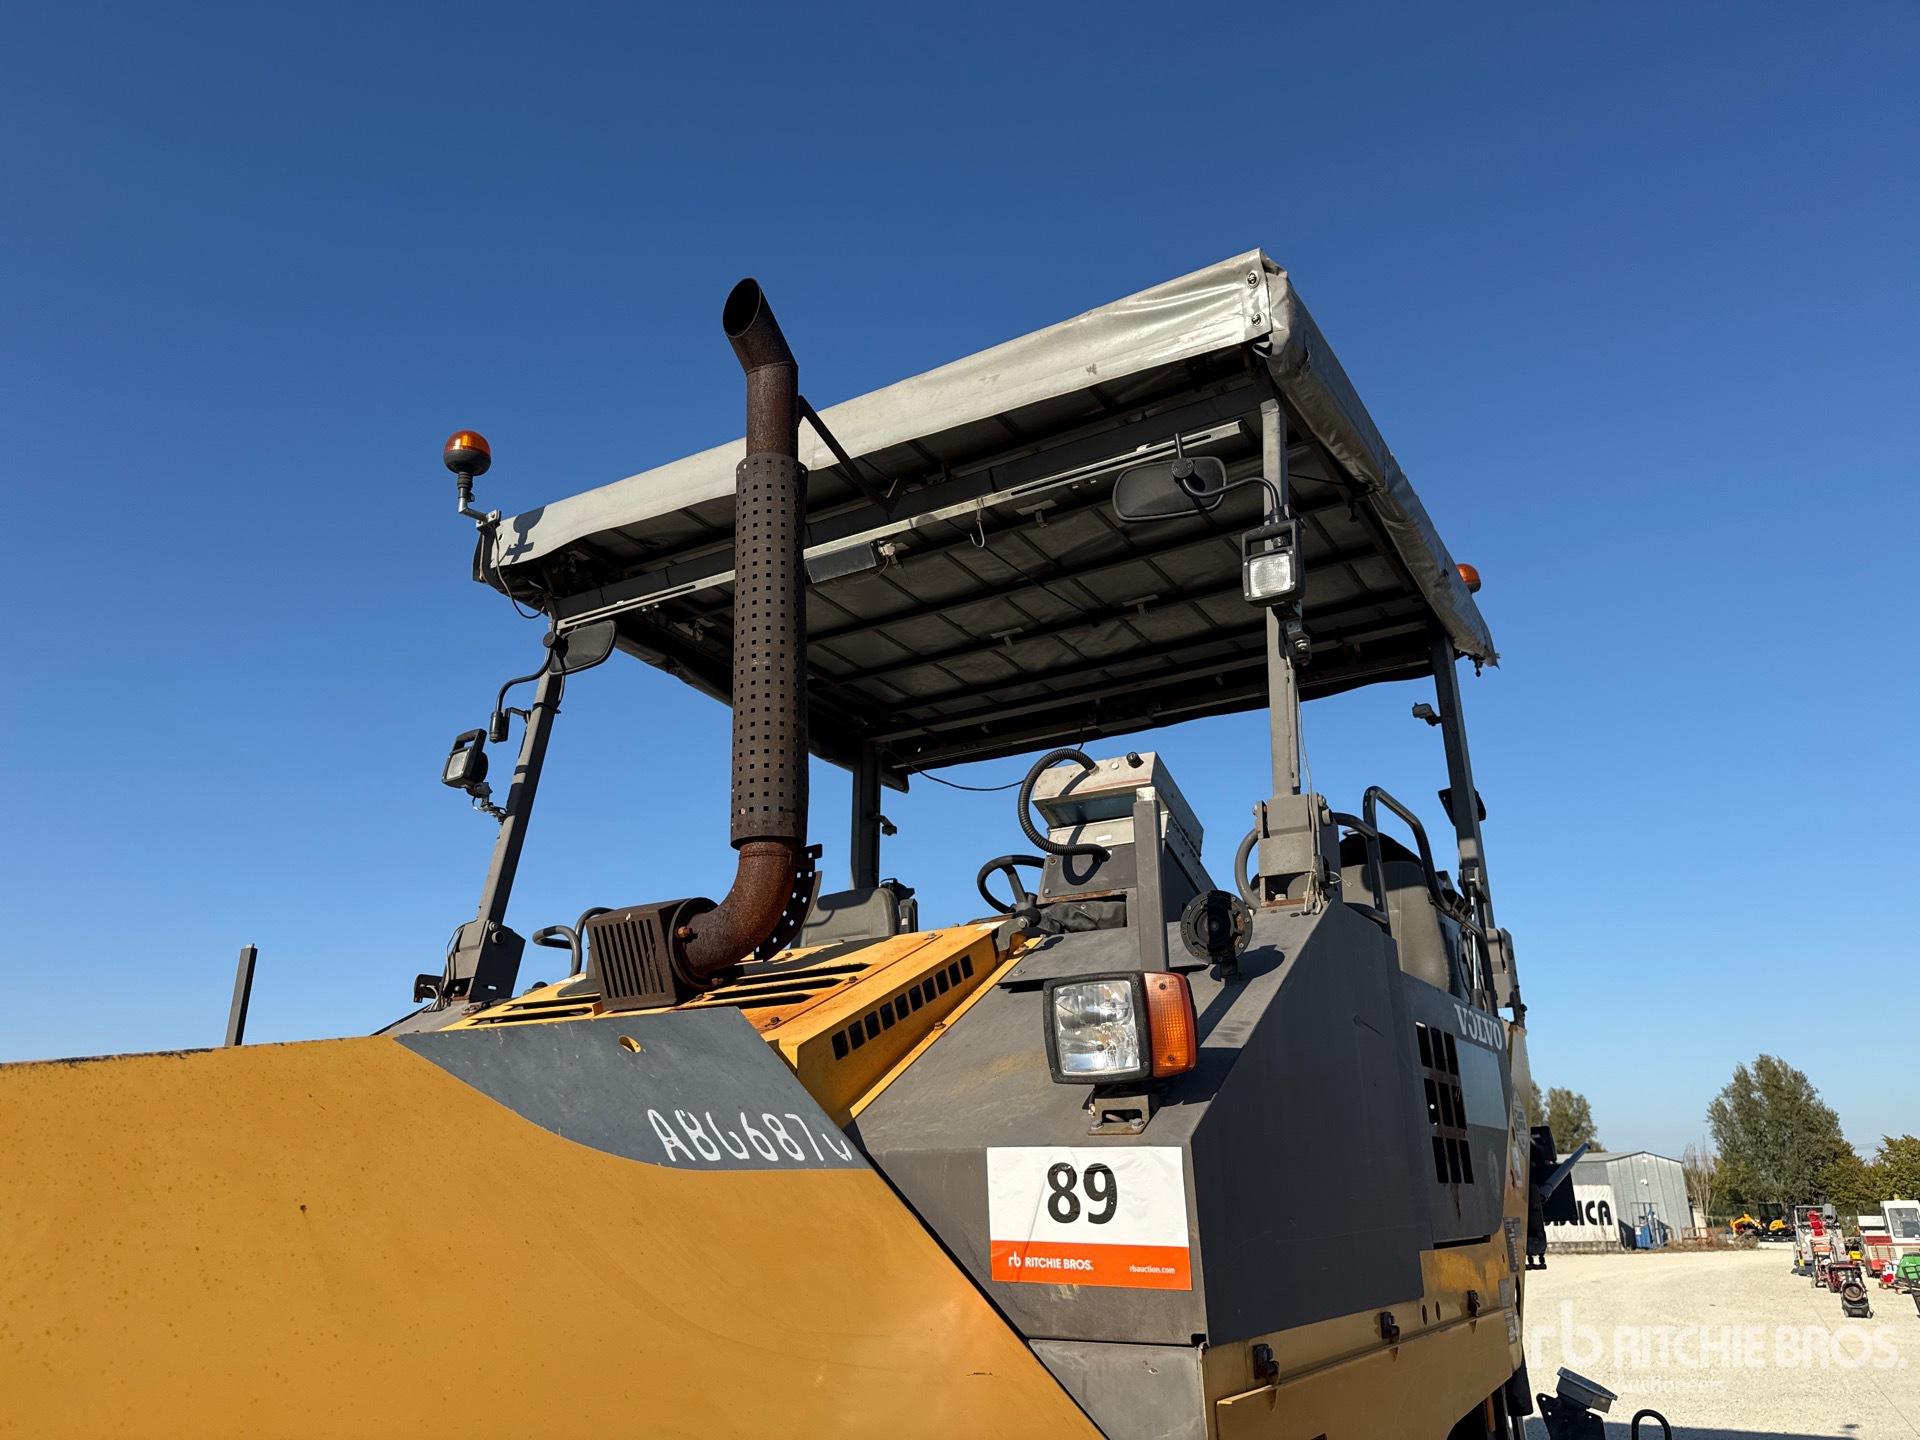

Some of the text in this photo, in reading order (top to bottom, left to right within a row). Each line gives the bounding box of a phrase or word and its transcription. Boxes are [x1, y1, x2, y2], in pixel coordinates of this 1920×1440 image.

[1047, 1162, 1118, 1225] 89
[1024, 1256, 1062, 1269] RITCHIE
[1063, 1258, 1094, 1271] BROS.
[1129, 1264, 1176, 1274] rbauction.com
